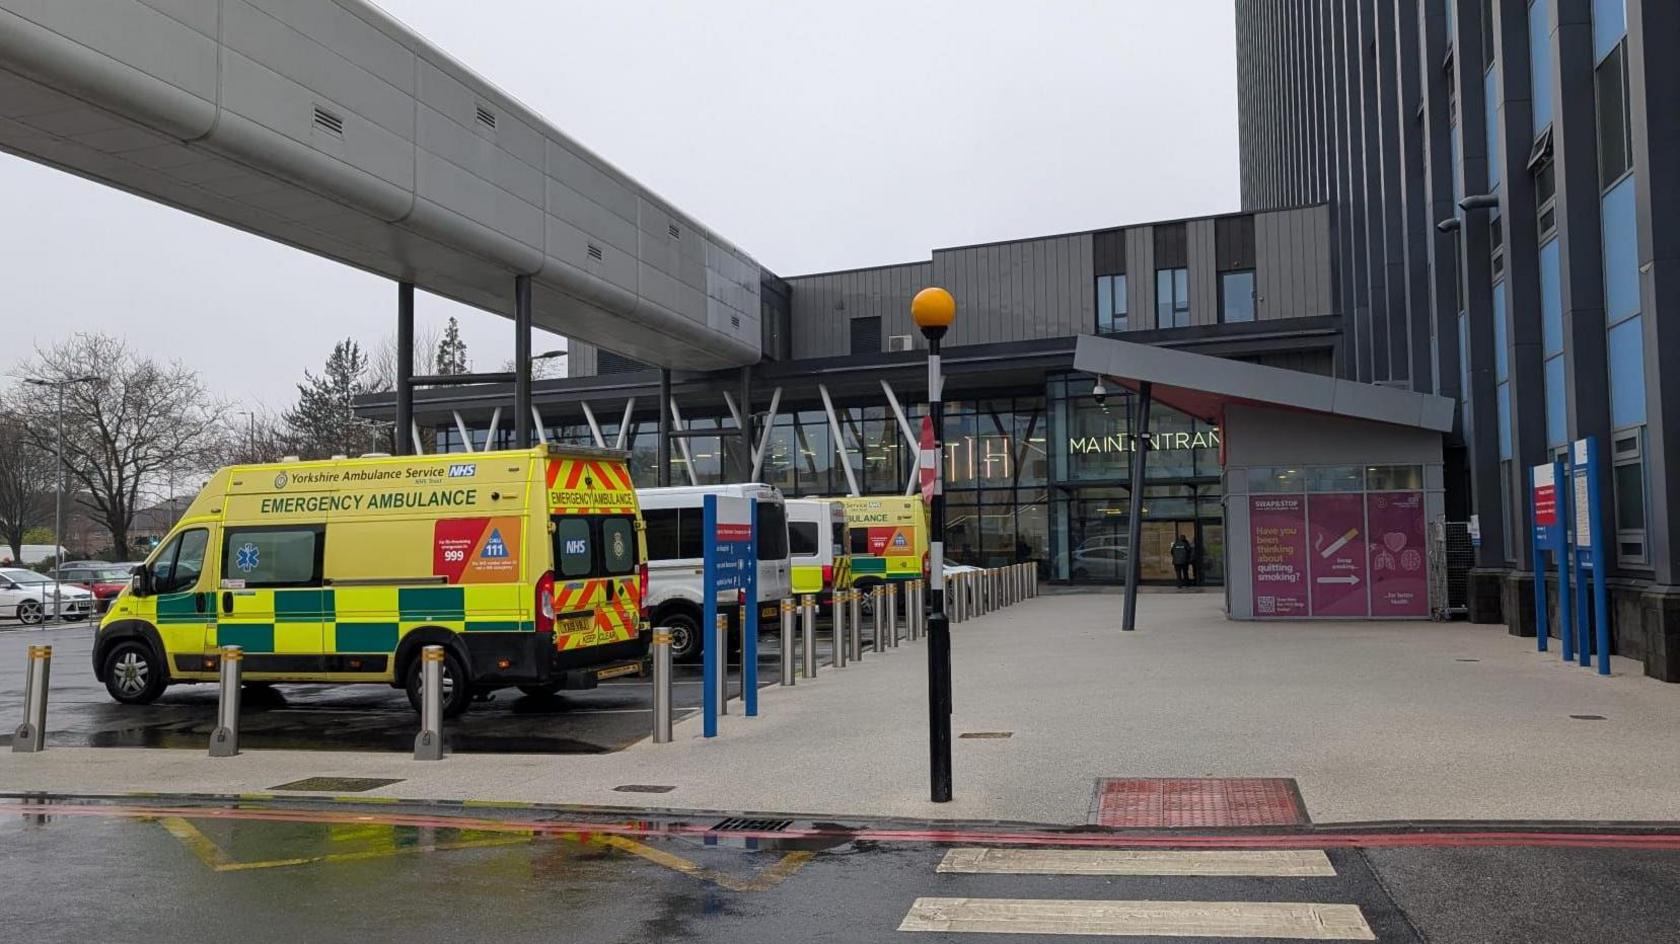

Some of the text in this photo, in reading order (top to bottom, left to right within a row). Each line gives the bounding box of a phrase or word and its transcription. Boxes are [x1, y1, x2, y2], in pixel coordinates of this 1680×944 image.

[1070, 436, 1123, 454] MAIN
[291, 464, 475, 484] Yorkshire Ambulance Service NHS
[261, 489, 477, 513] EMERGENCY AMBULANCE
[552, 491, 633, 505] EMERGENCY AMBULANCE
[1256, 527, 1297, 537] Have you
[1257, 536, 1279, 544] been
[486, 545, 503, 556] 111
[566, 540, 585, 554] NHS
[1257, 545, 1294, 556] thinking
[444, 550, 464, 561] 999
[1258, 563, 1293, 574] quitting
[1258, 573, 1300, 583] smoking?
[582, 630, 616, 643] KEEP CLEAR
